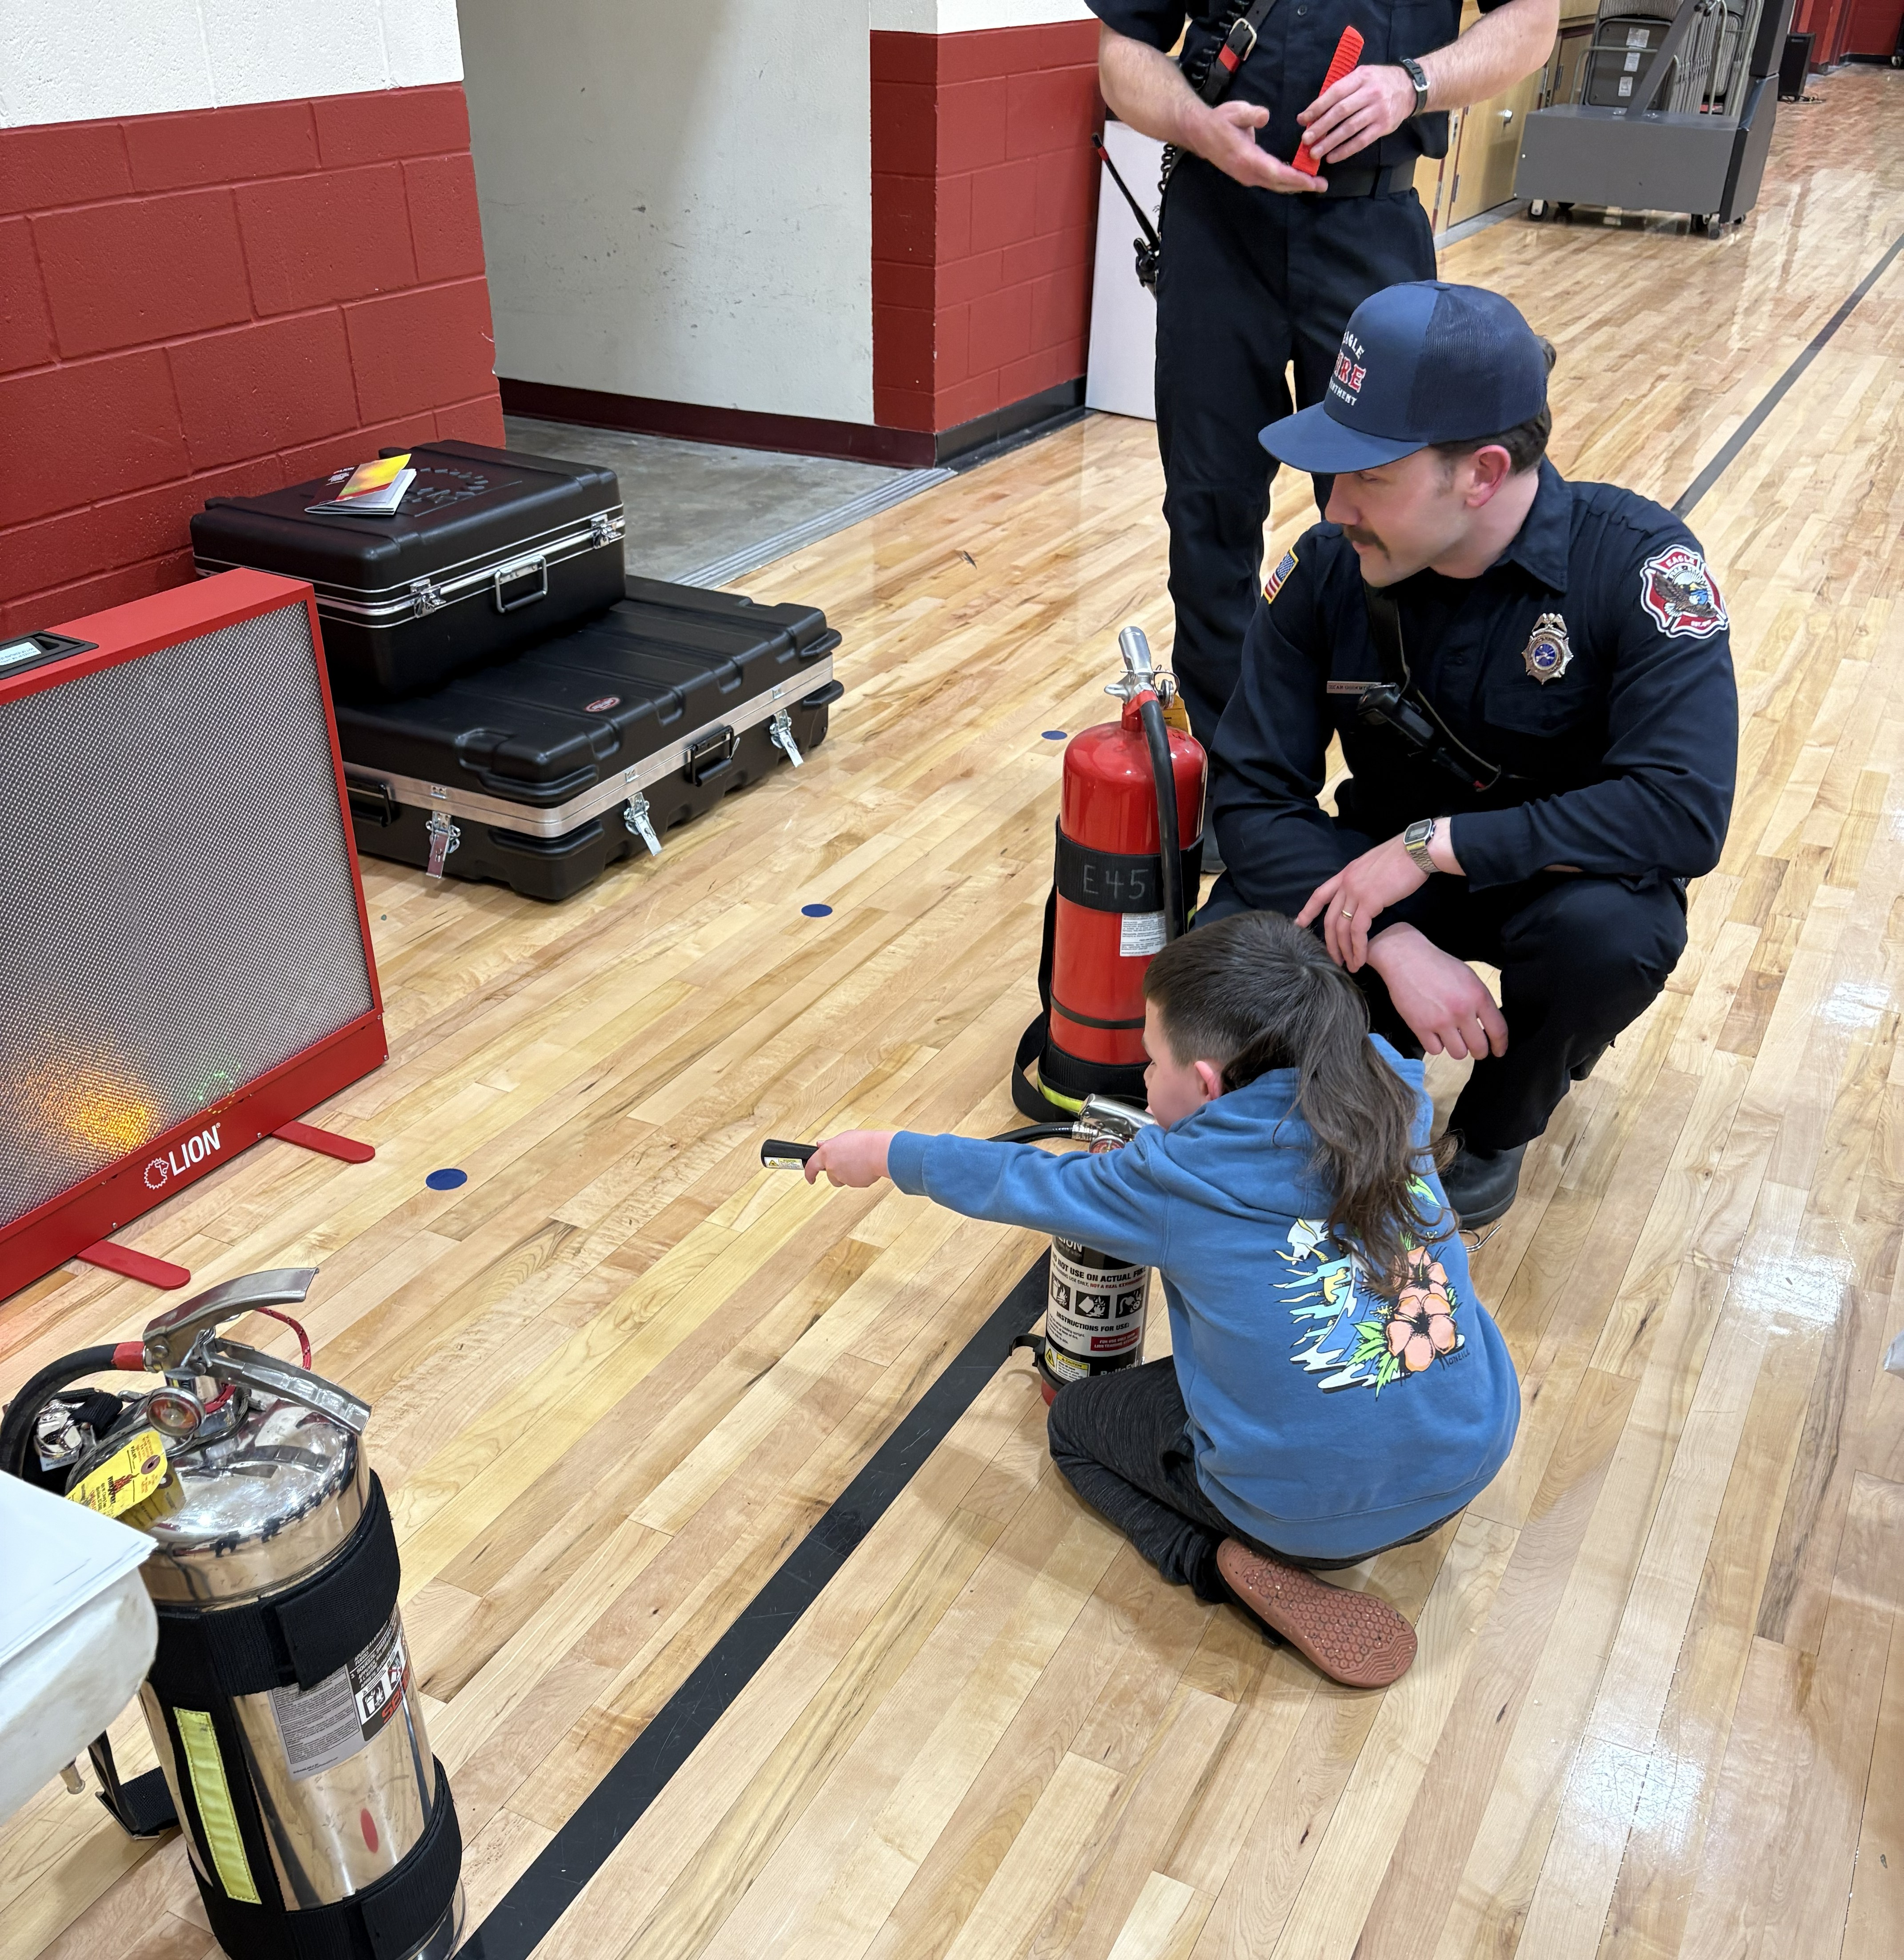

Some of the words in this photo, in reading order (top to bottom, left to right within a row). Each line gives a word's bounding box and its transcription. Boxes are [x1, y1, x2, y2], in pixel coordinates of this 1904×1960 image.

[1334, 350, 1366, 393] IRE
[1665, 555, 1695, 567] EAGLE
[1058, 1258, 1068, 1272] NOT
[1070, 1267, 1084, 1279] USE
[1087, 1273, 1098, 1281] ON
[1100, 1272, 1132, 1282] ACTUAL
[1056, 1311, 1099, 1332] INSTRUCTIONS
[1116, 1322, 1130, 1331] USE:
